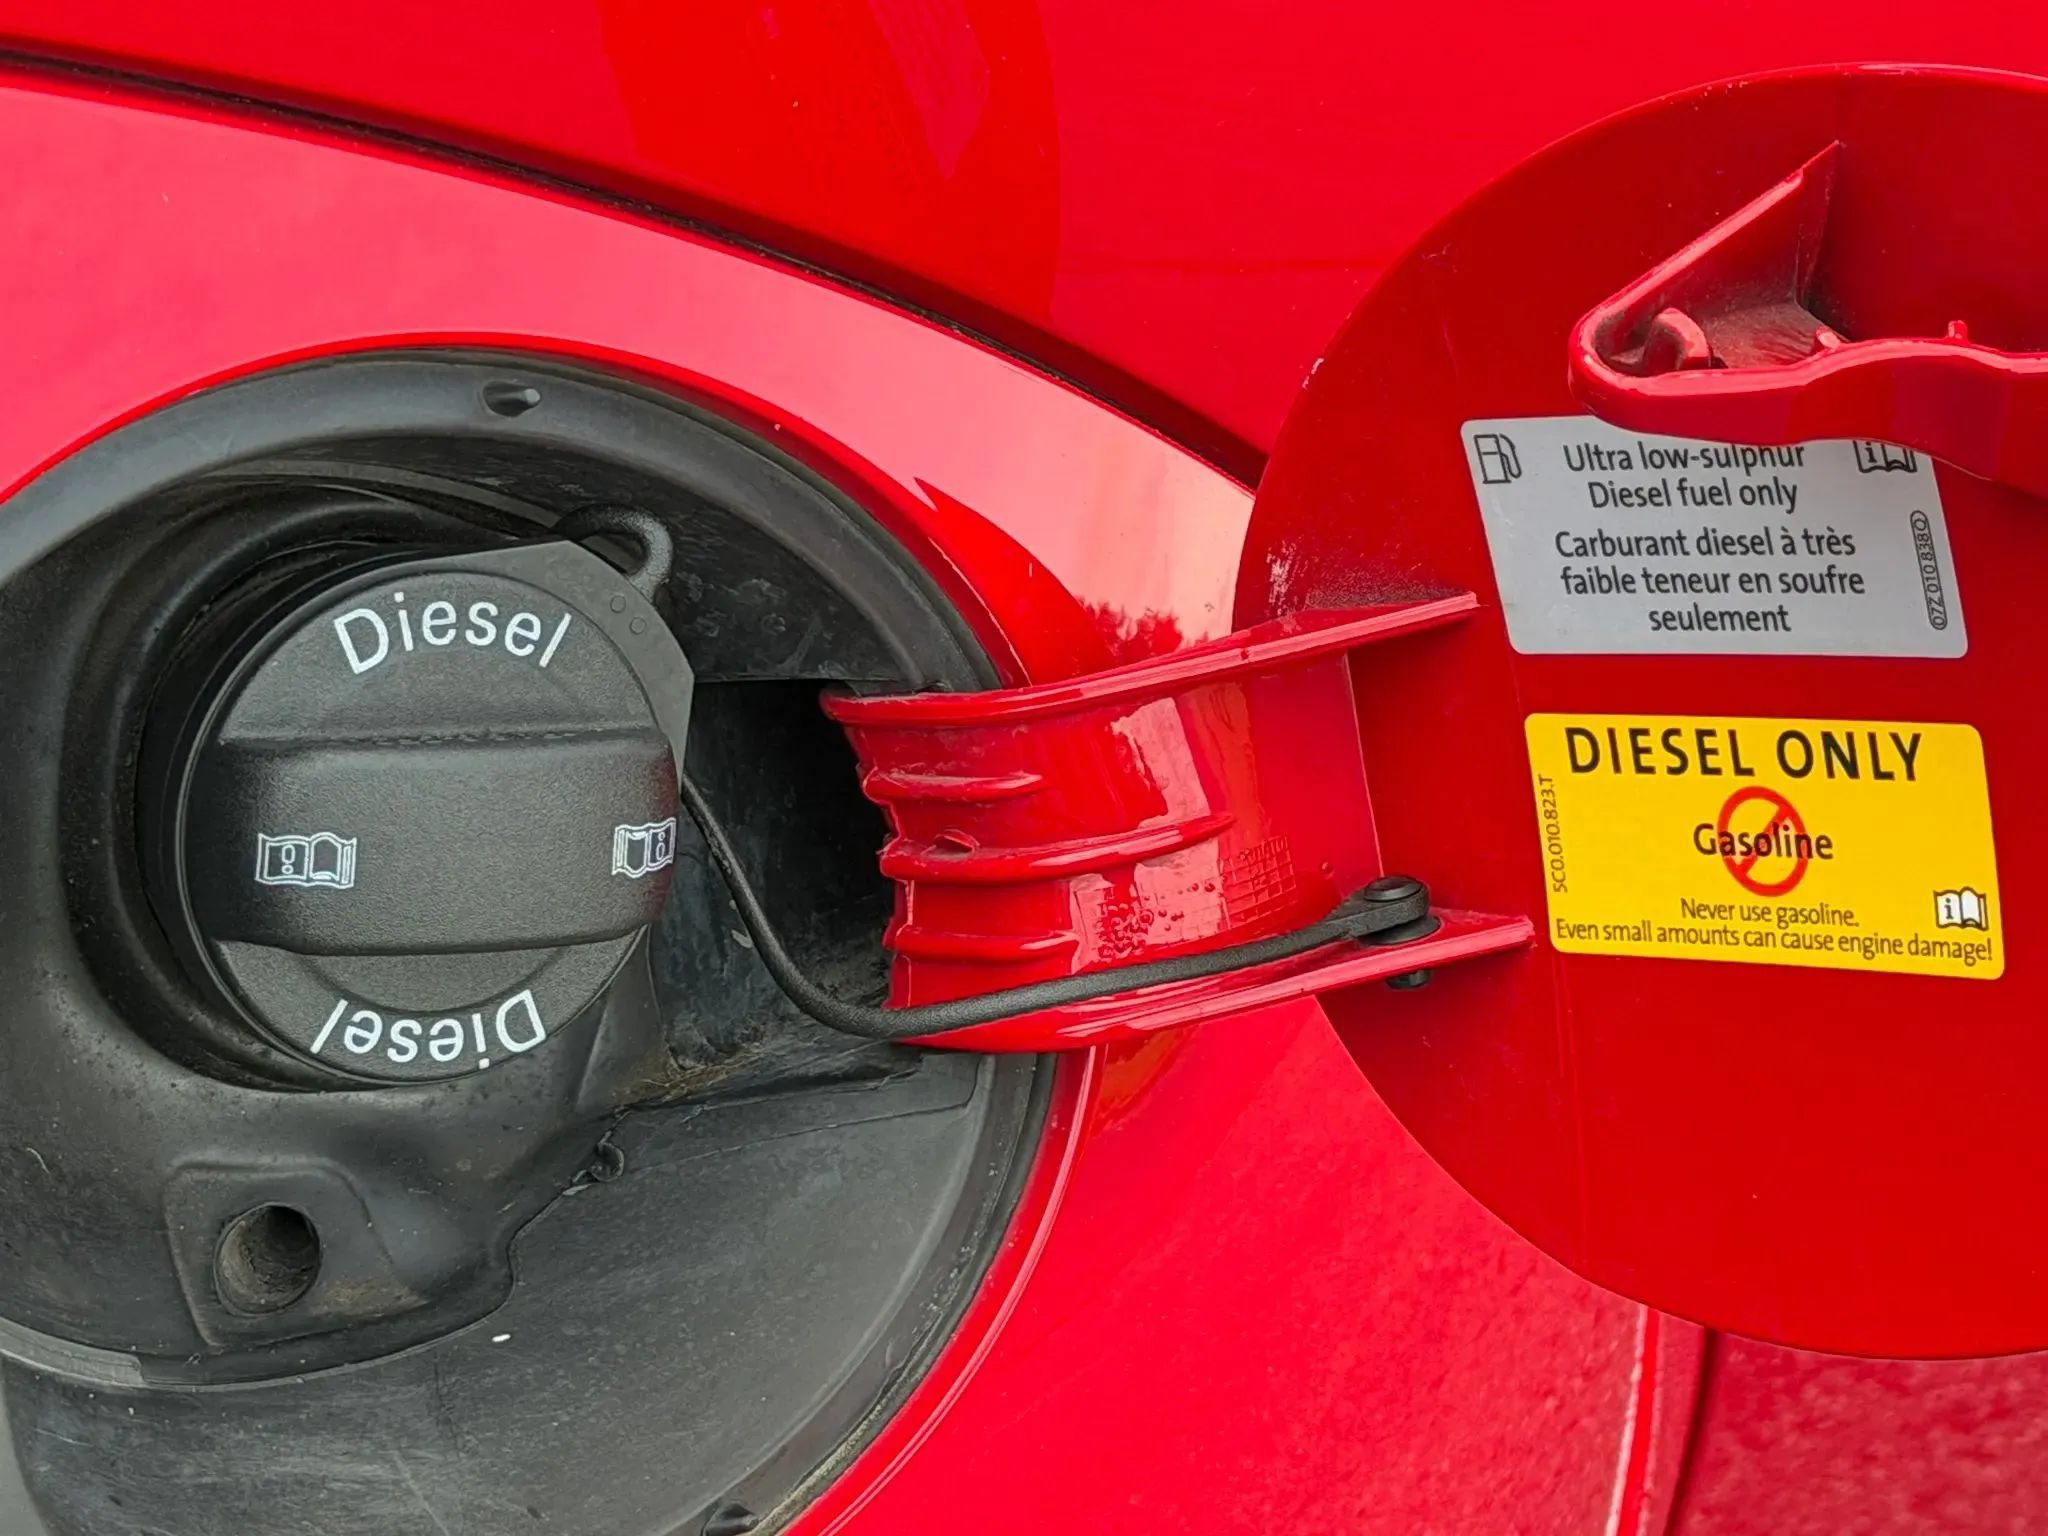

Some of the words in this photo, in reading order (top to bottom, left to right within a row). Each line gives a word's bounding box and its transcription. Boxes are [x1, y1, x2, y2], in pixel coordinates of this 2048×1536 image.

[1564, 444, 1633, 472] Ultra
[1588, 479, 1671, 508] Diesel
[1676, 477, 1731, 506] fuel
[1739, 476, 1799, 514] only
[1555, 528, 1690, 558] Carburant
[1696, 526, 1774, 556] diesel
[1781, 527, 1798, 555] à
[1802, 526, 1857, 556] très
[1560, 567, 1636, 595] faible
[1643, 568, 1731, 594] teneur
[1738, 572, 1773, 594] en
[1778, 565, 1866, 595] soufre
[1923, 564, 1939, 593] 010
[1648, 604, 1792, 633] seulement
[1928, 596, 1945, 626] 07Z
[334, 592, 571, 674] Diesel
[1565, 726, 1755, 775] DIESEL
[1776, 730, 1922, 782] ONLY
[1693, 823, 1834, 861] Gasoline
[1680, 897, 1735, 921] Never
[1738, 903, 1772, 922] use
[1776, 903, 1860, 930] gasoline.
[1556, 918, 1599, 940] Even
[1602, 919, 1653, 942] small
[1656, 924, 1740, 946] amounts
[1743, 930, 1777, 949] can
[1780, 932, 1834, 950] cause
[1838, 932, 1904, 961] engine
[1907, 932, 1993, 967] damage!
[310, 988, 547, 1069] Diesel
